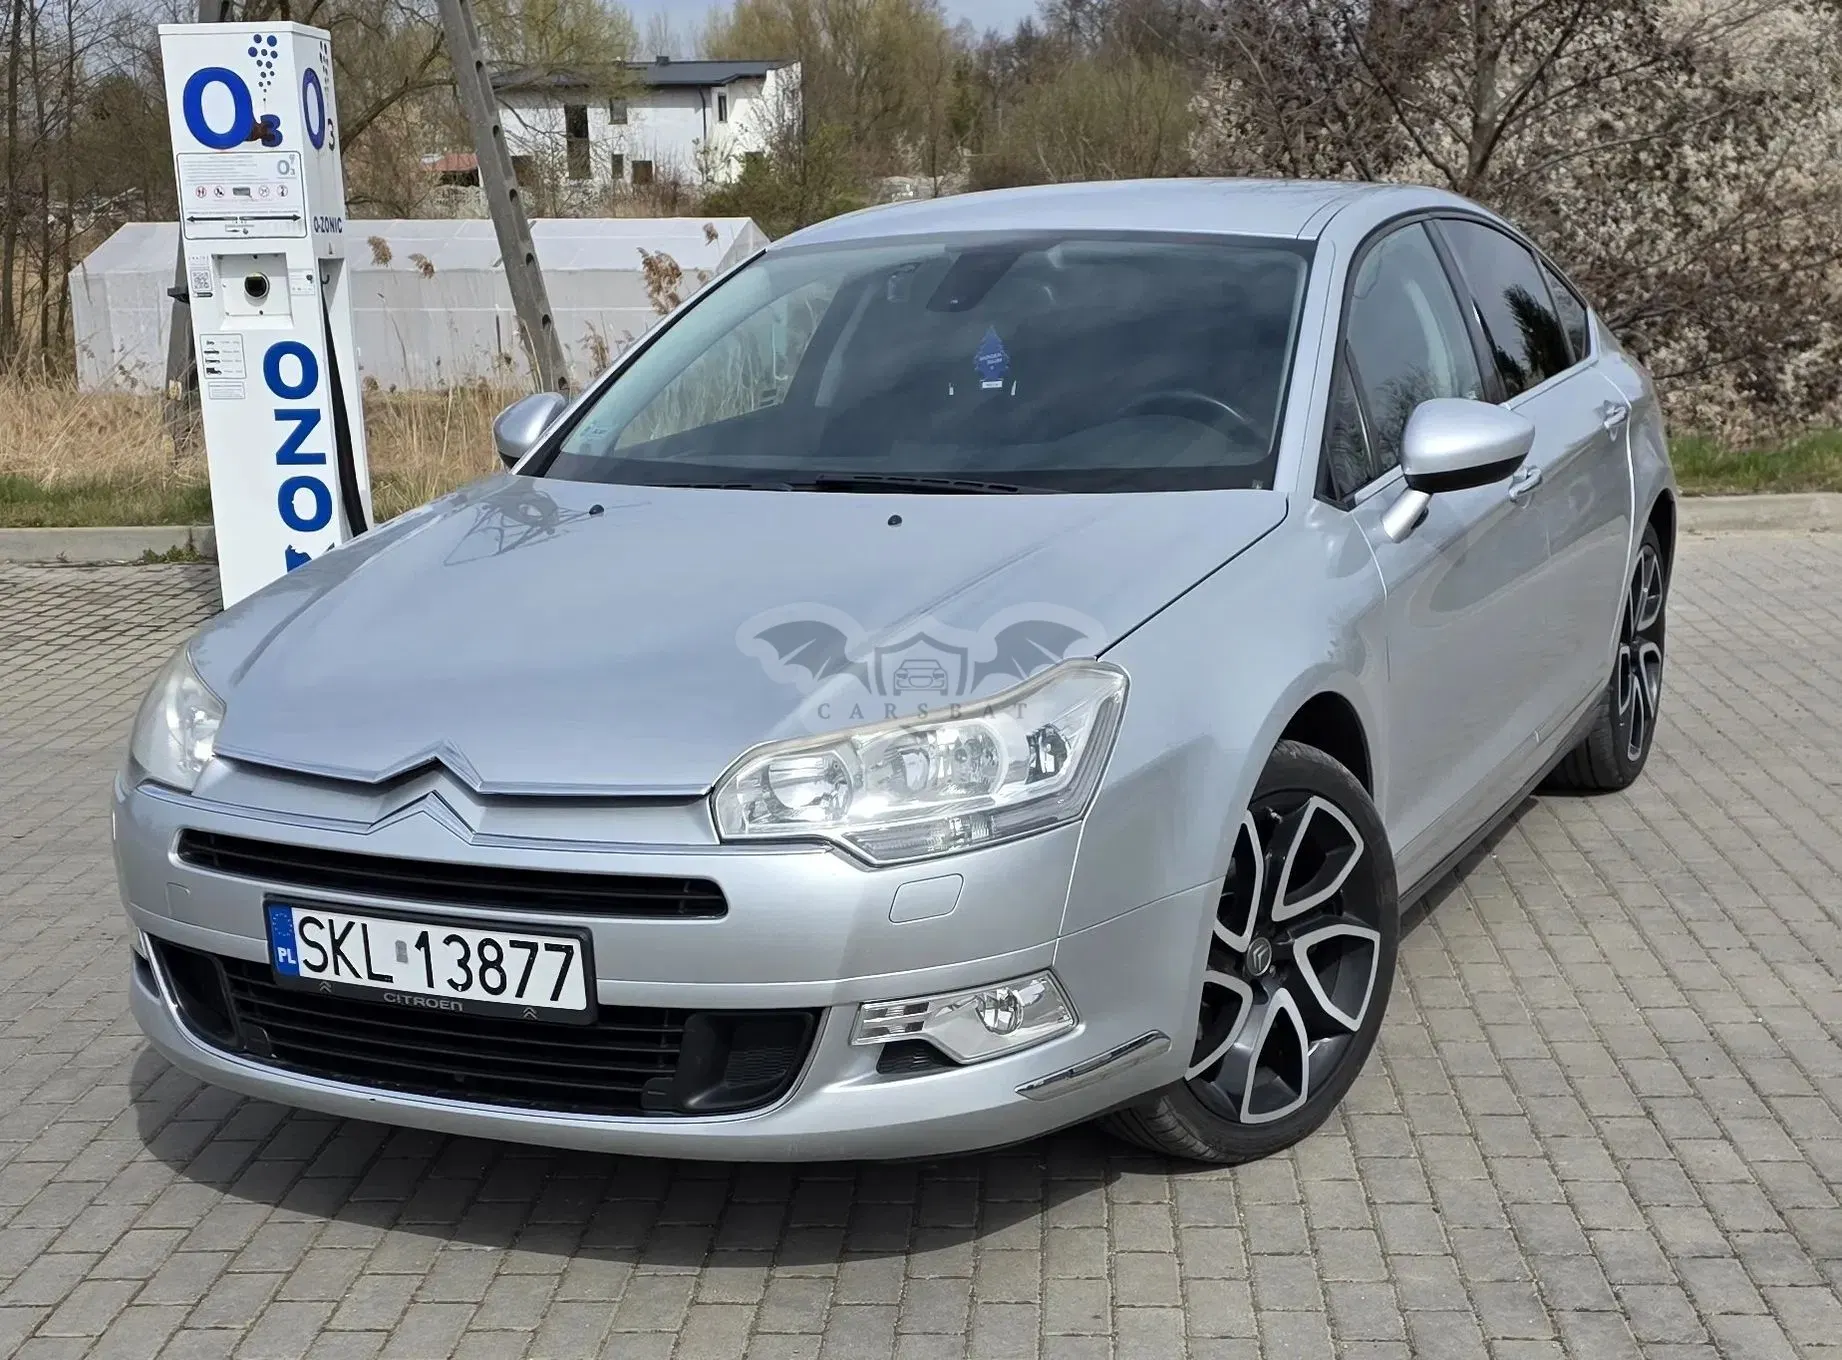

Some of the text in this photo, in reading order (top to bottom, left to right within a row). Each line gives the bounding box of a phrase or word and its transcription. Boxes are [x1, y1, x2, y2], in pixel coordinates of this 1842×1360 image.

[263, 341, 335, 573] OZO
[277, 946, 297, 965] PL
[298, 916, 575, 1002] SKL 13877
